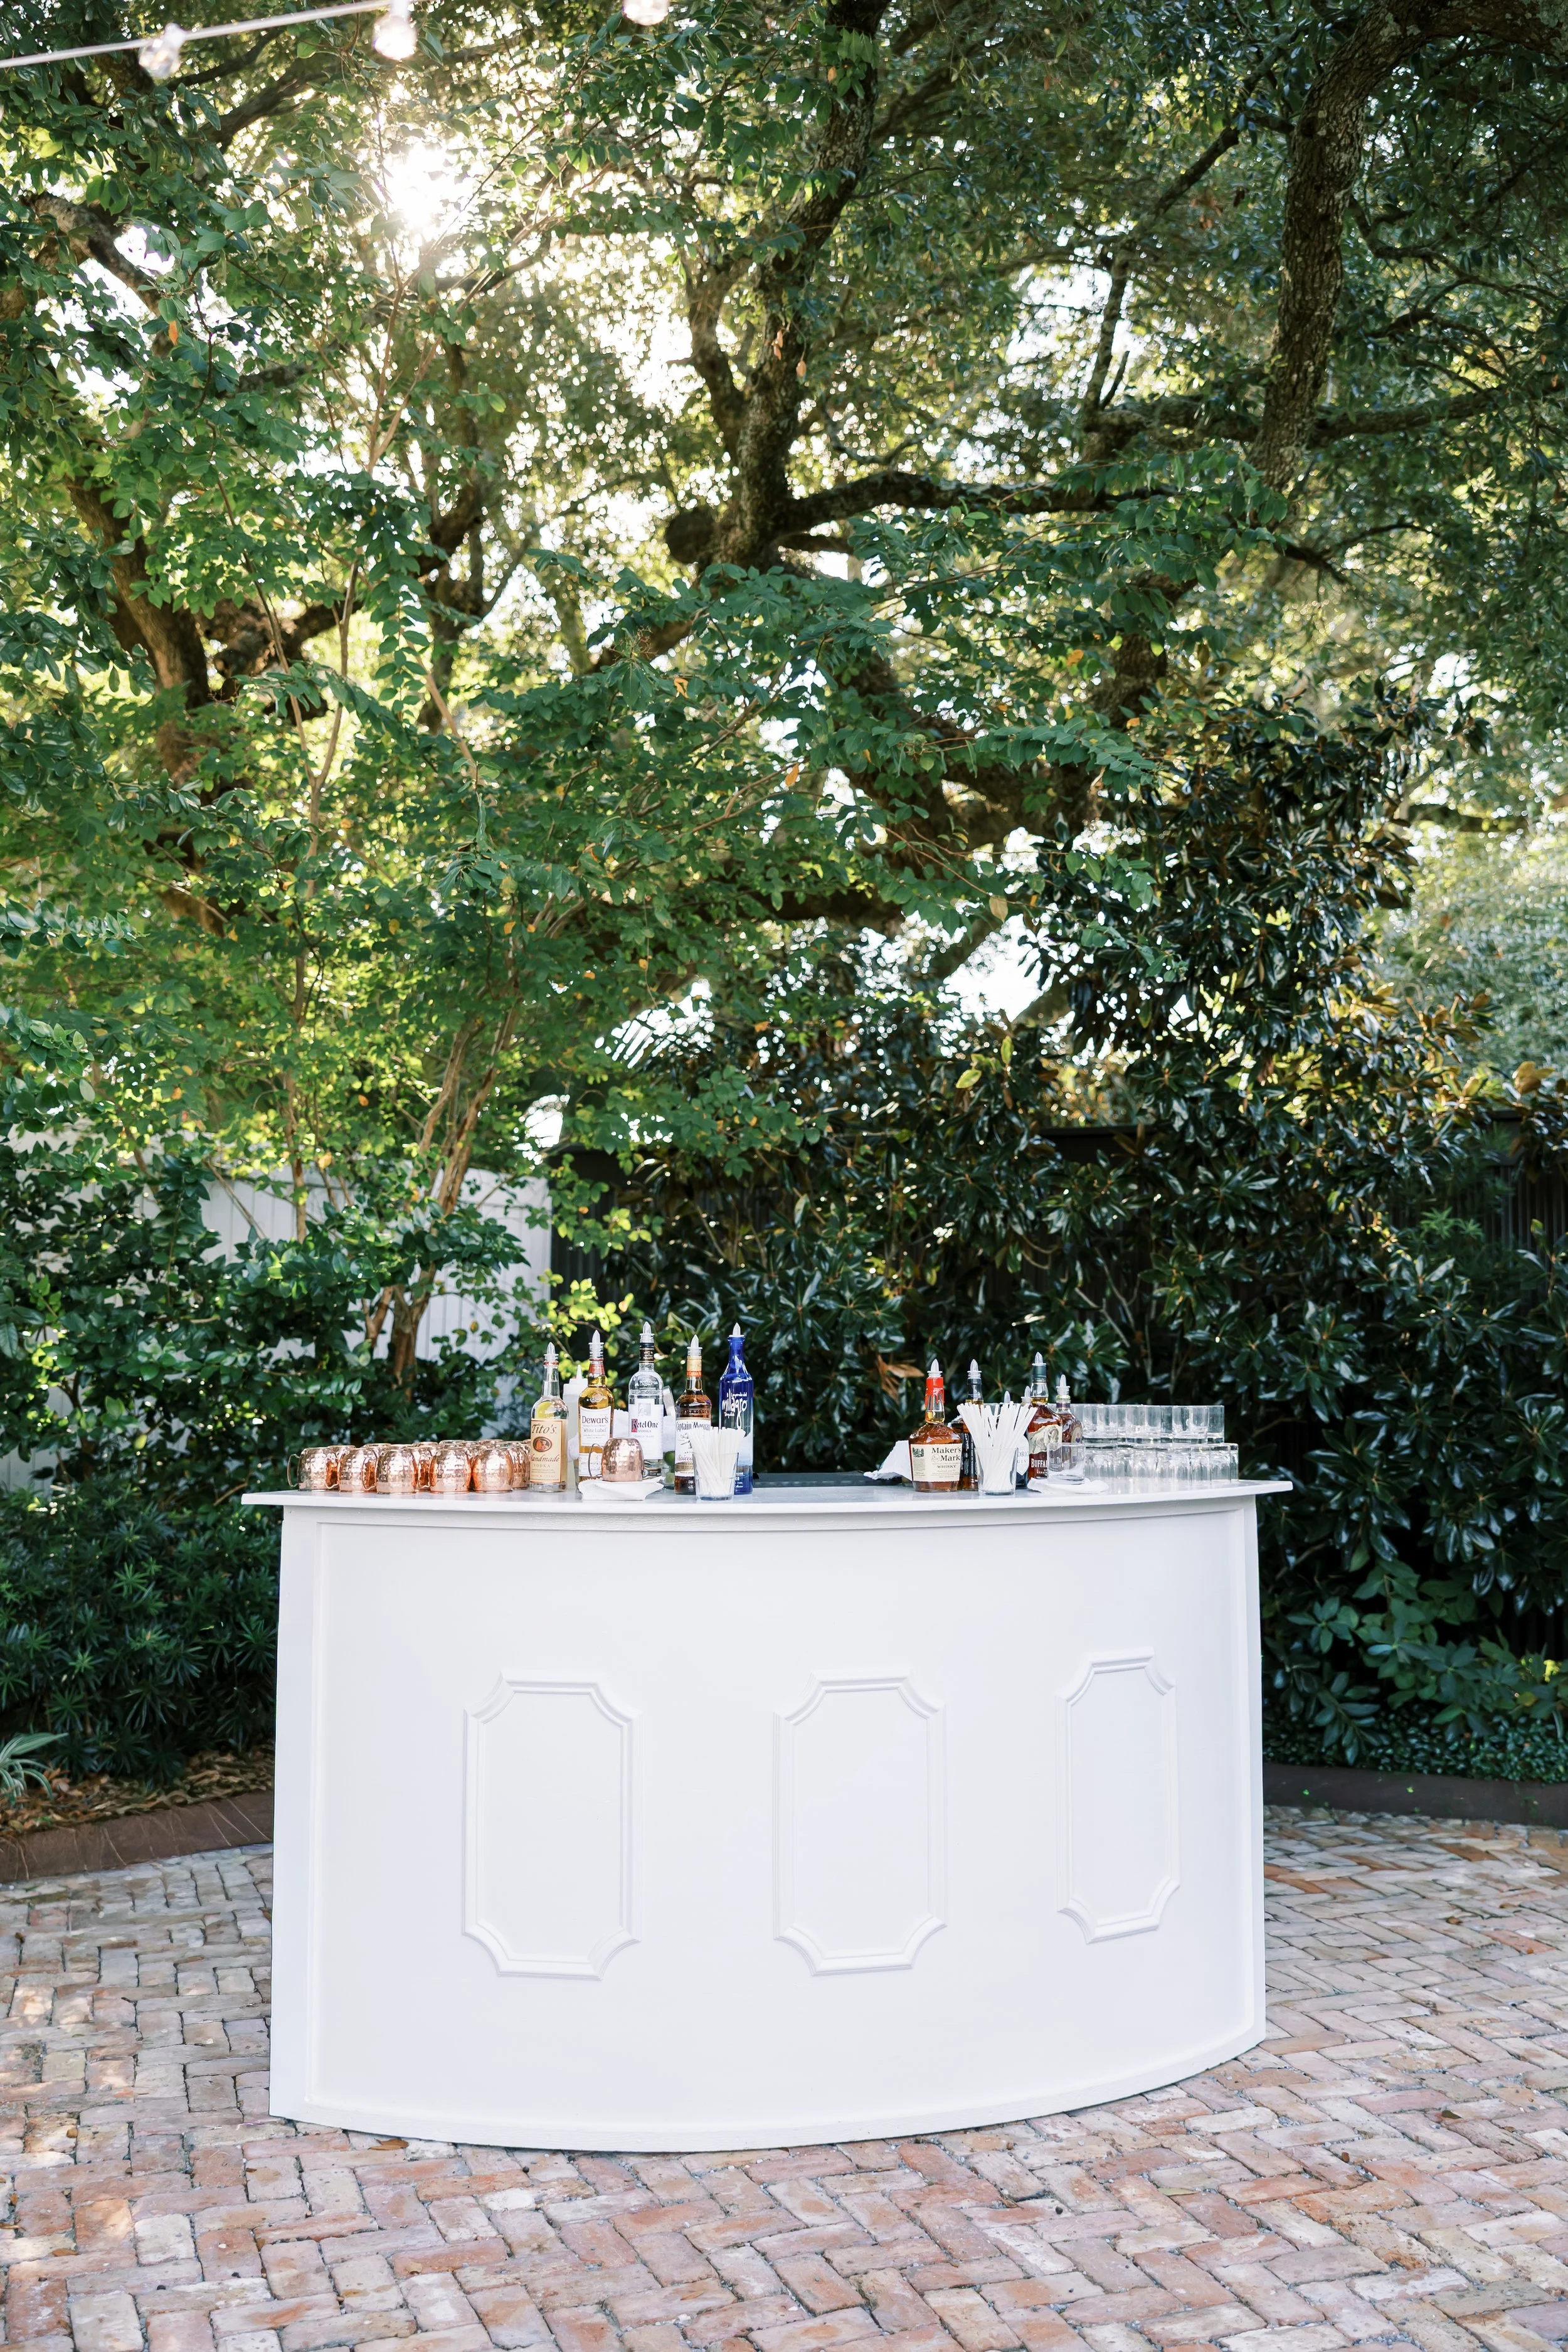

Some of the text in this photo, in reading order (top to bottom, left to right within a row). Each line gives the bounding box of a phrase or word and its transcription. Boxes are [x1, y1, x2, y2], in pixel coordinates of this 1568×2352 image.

[582, 1416, 608, 1424] Dewar's
[532, 1424, 556, 1434] Tito's
[631, 1419, 647, 1433] Ketel
[676, 1422, 692, 1431] Captain
[1031, 1458, 1047, 1468] BUFFAL
